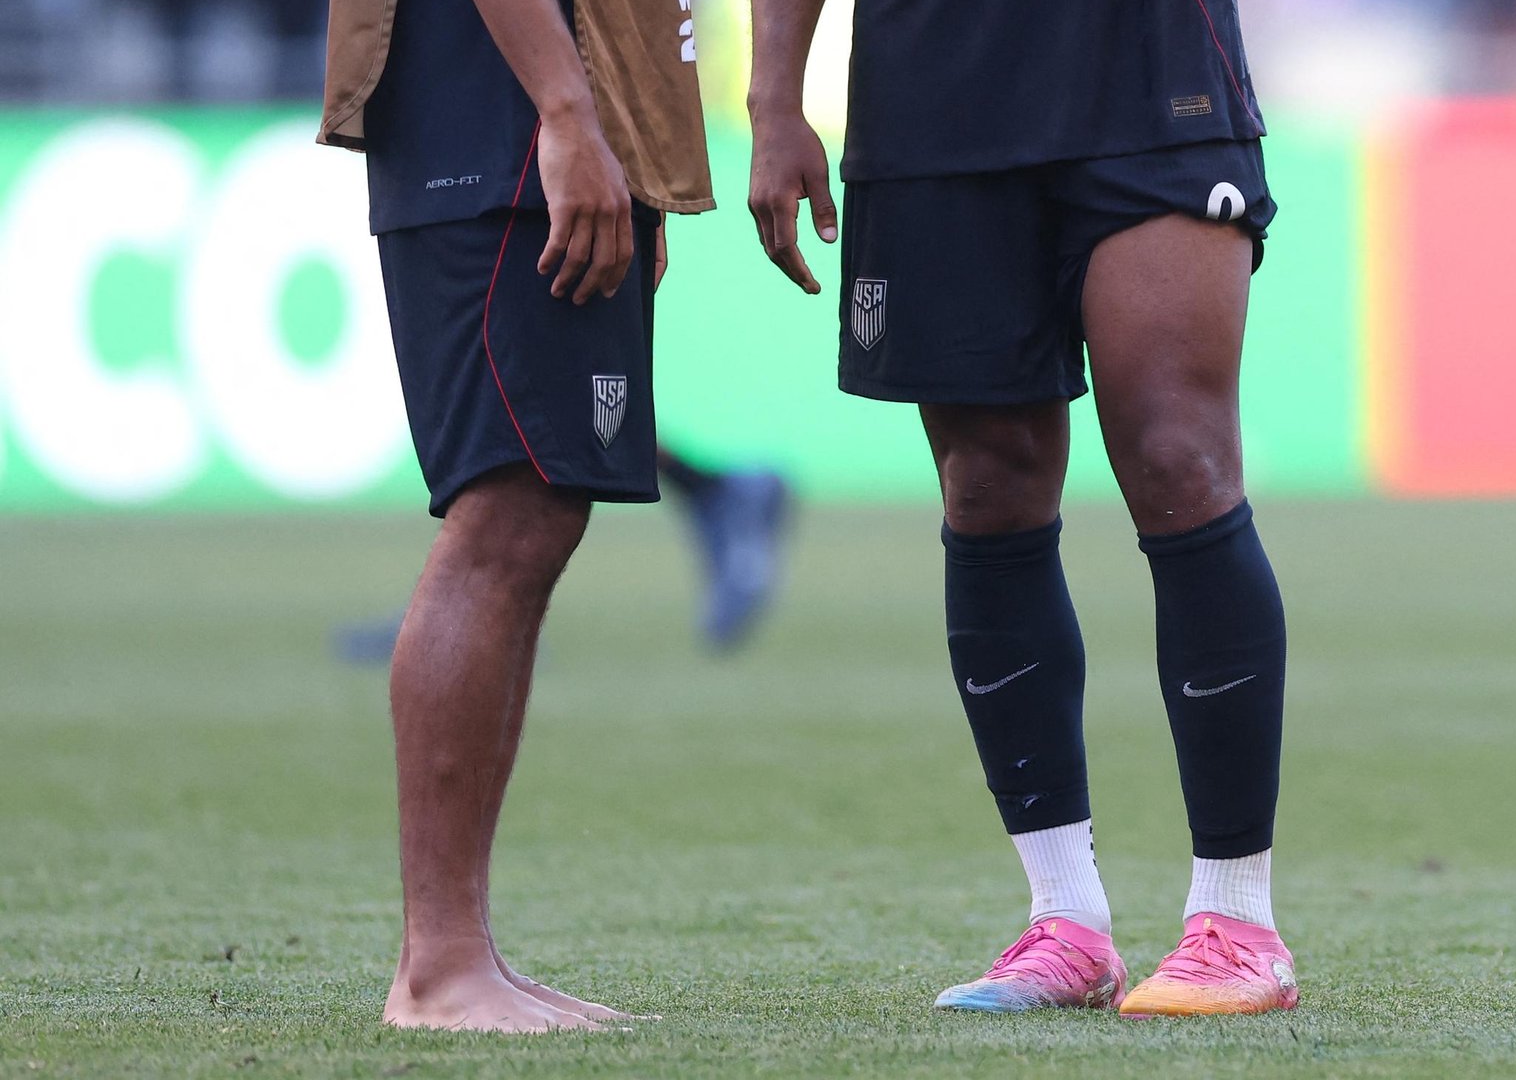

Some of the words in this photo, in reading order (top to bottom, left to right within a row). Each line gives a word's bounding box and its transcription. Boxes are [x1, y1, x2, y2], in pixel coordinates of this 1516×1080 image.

[425, 174, 482, 190] AERO-FIT
[855, 282, 884, 310] USA
[596, 380, 625, 408] USA
